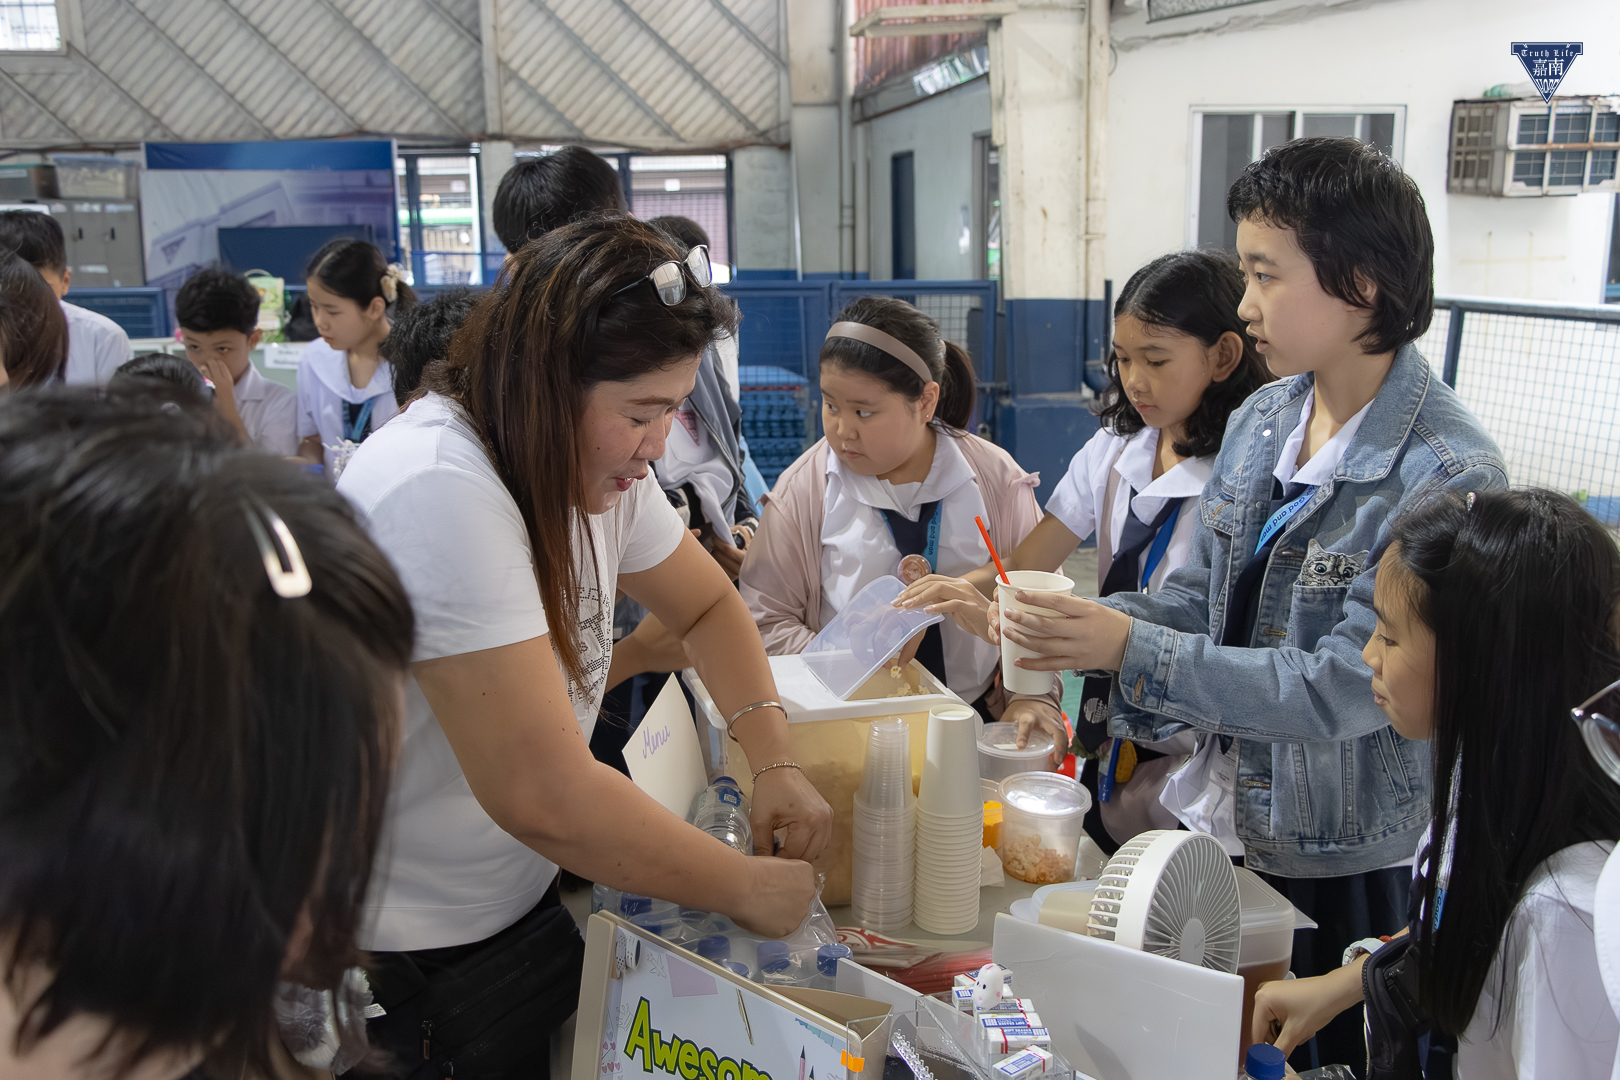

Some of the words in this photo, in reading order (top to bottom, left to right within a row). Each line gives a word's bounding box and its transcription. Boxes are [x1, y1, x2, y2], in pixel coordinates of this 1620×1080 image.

[1288, 496, 1305, 513] God
[1272, 510, 1287, 527] and
[642, 725, 671, 759] Menu
